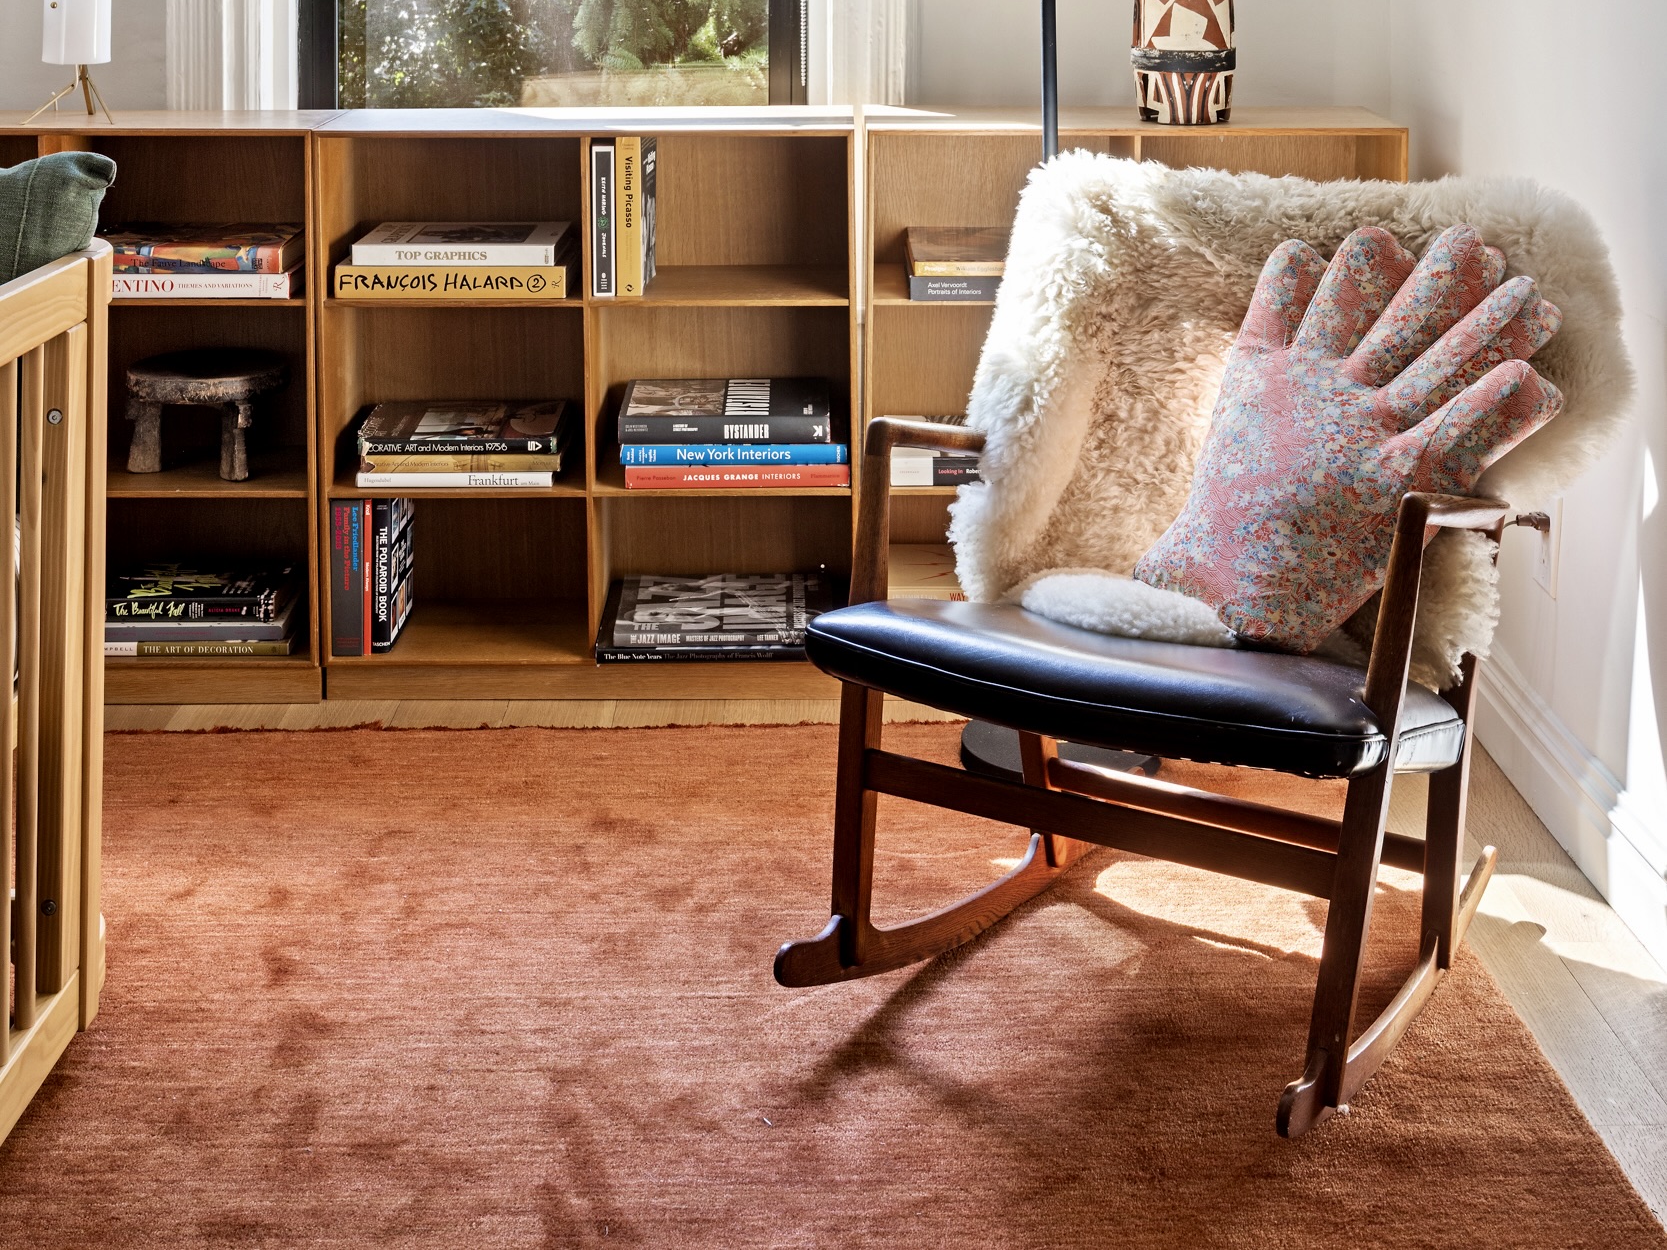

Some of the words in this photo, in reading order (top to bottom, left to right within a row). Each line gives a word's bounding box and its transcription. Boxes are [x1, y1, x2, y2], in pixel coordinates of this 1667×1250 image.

[623, 156, 633, 191] Visiting
[625, 194, 633, 228] Picasso
[395, 250, 421, 261] TOP
[424, 250, 488, 261] GRAPHICS
[131, 258, 149, 268] The
[151, 258, 177, 268] Fauve
[179, 257, 226, 269] Landscape
[339, 273, 438, 292] FRANÇOIS
[444, 272, 524, 291] HALARD
[724, 424, 770, 439] BYSTANDER
[404, 443, 418, 452] ART
[417, 443, 431, 452] and
[432, 443, 459, 452] Modern
[460, 443, 484, 452] Interiors
[676, 448, 705, 461] New
[707, 448, 735, 461] York
[737, 448, 791, 461] Interiors
[467, 474, 519, 486] Frankfurt
[343, 507, 351, 536] Family
[344, 536, 349, 544] in
[380, 526, 388, 545] THE
[379, 547, 388, 593] POLAROID
[113, 602, 129, 616] The
[131, 601, 164, 619] Beautiful
[166, 601, 186, 618] Fall
[379, 595, 388, 622] BOOK
[637, 634, 654, 644] JAZZ
[657, 634, 681, 644] IMAGE
[144, 645, 162, 654] THE
[164, 645, 182, 653] ART
[183, 645, 196, 653] OF
[198, 645, 254, 653] DECORATION
[689, 653, 726, 661] Photography
